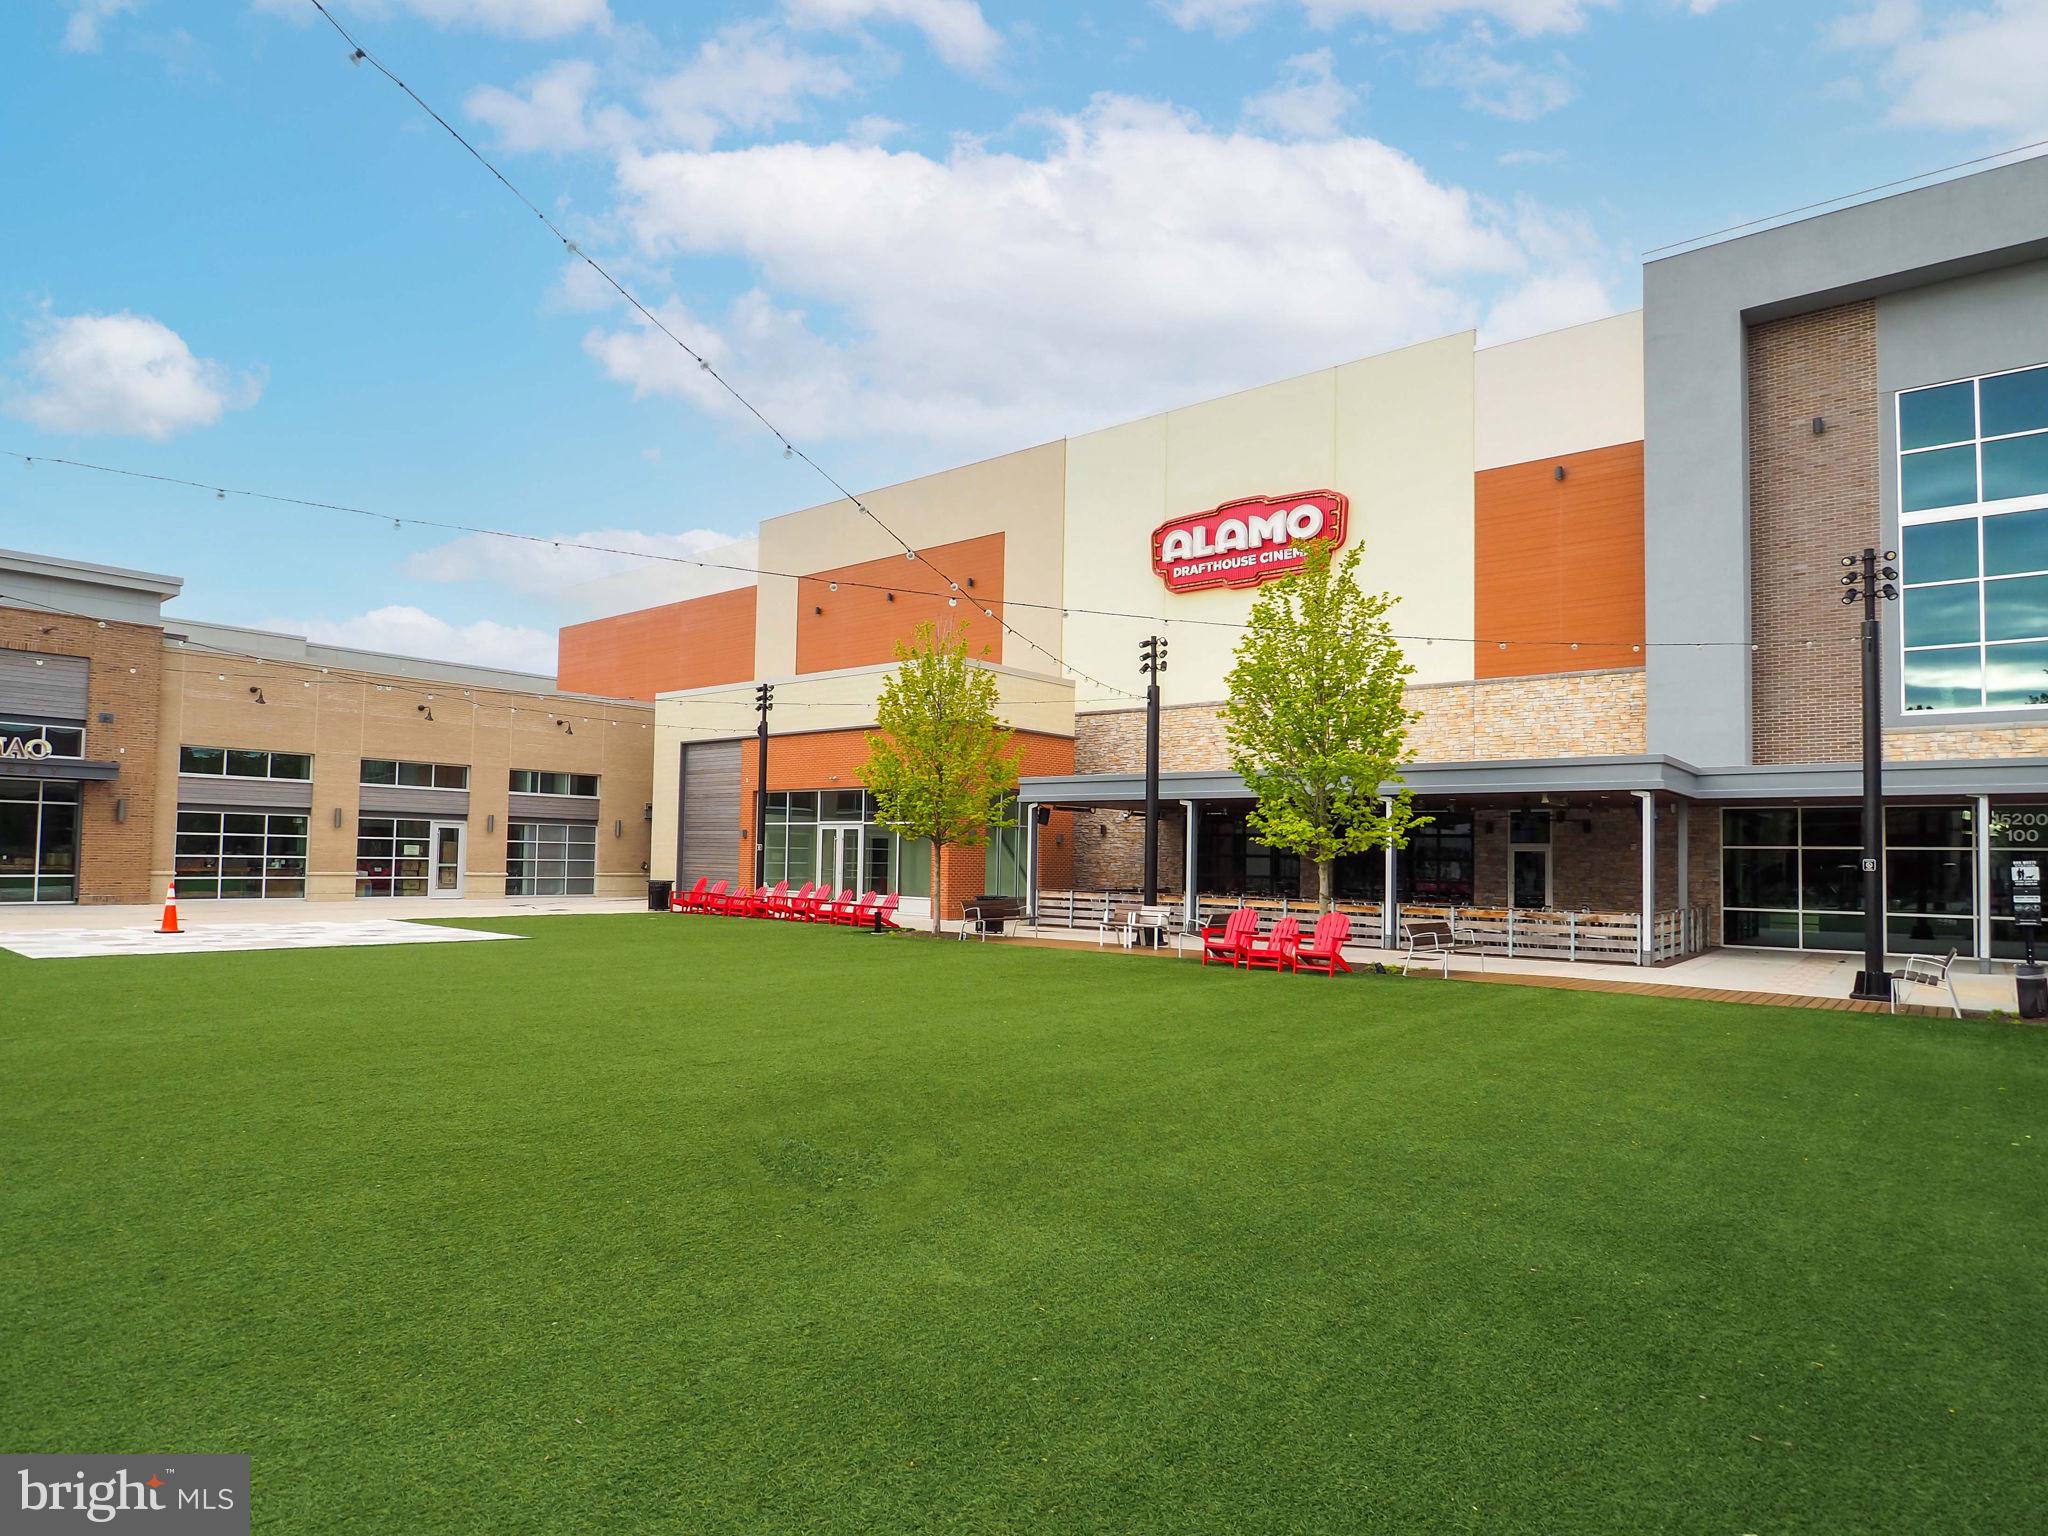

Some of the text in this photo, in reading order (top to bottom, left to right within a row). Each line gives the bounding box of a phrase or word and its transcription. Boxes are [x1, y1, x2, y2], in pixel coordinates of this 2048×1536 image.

[1162, 504, 1324, 563] ALAMO
[1173, 547, 1308, 578] DRAFTHOUSE CINEM
[2005, 829, 2039, 842] 100
